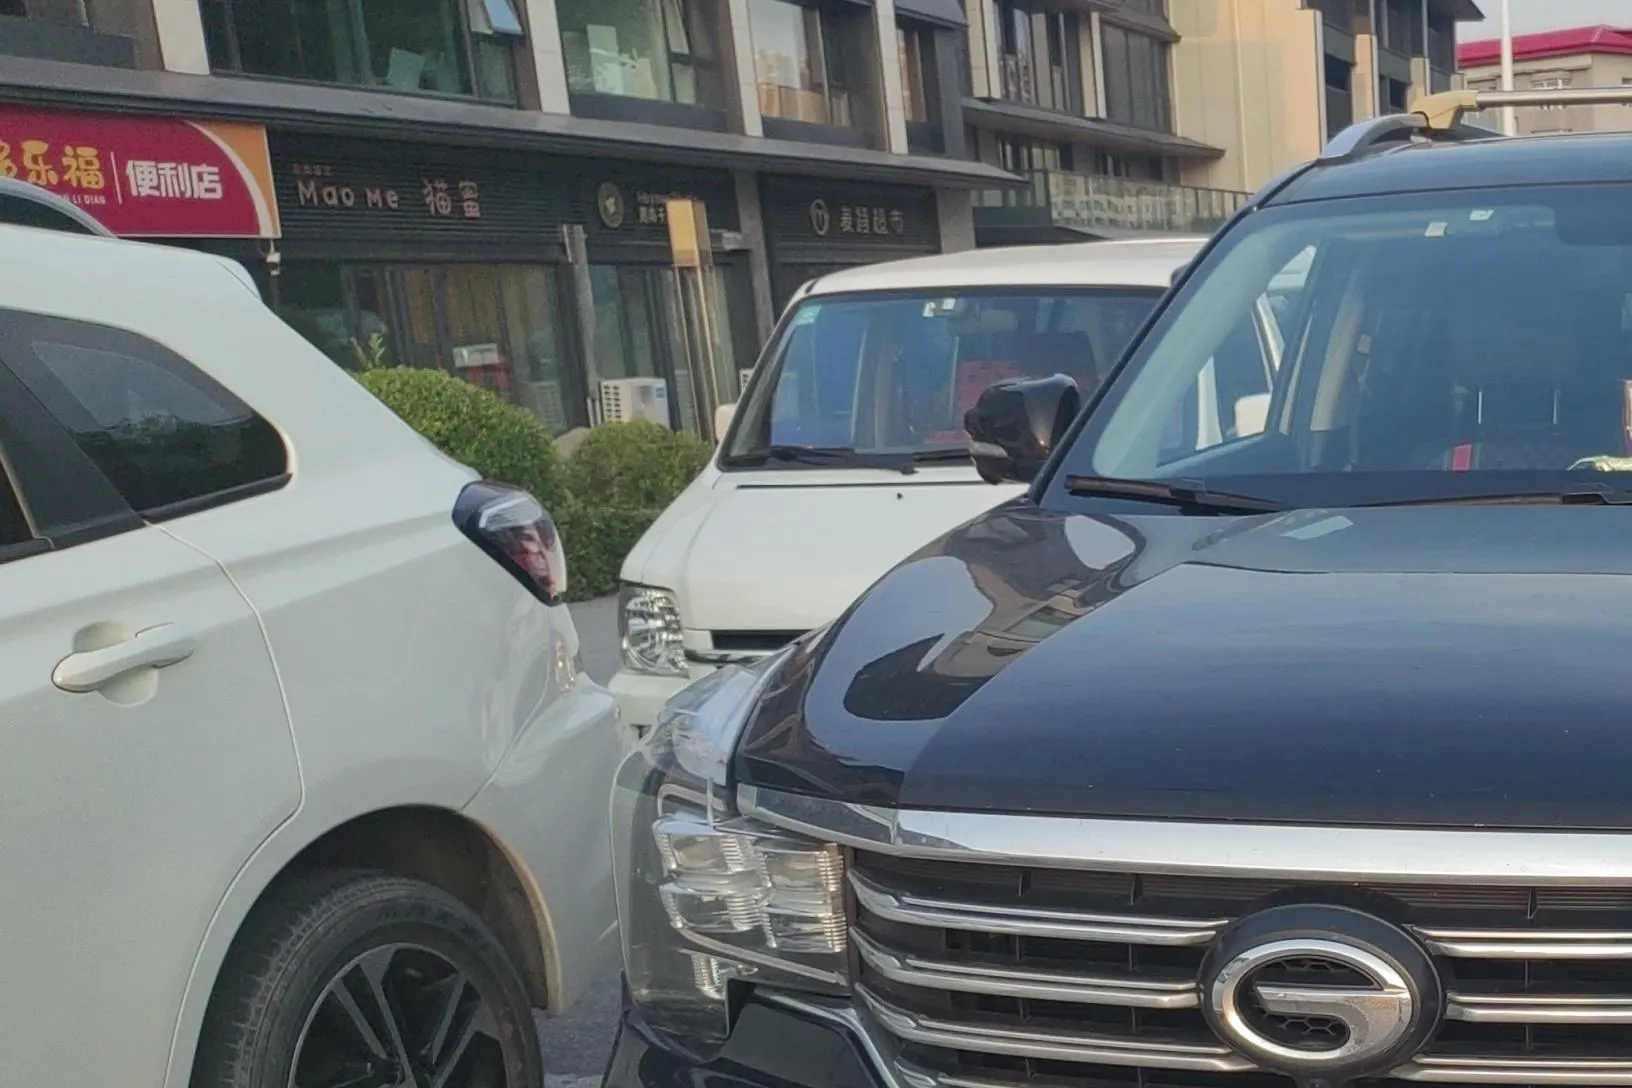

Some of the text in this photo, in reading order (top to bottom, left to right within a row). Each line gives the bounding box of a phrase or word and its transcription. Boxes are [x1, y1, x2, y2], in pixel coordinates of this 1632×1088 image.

[126, 160, 223, 199] 便利店
[297, 180, 354, 207] Mao
